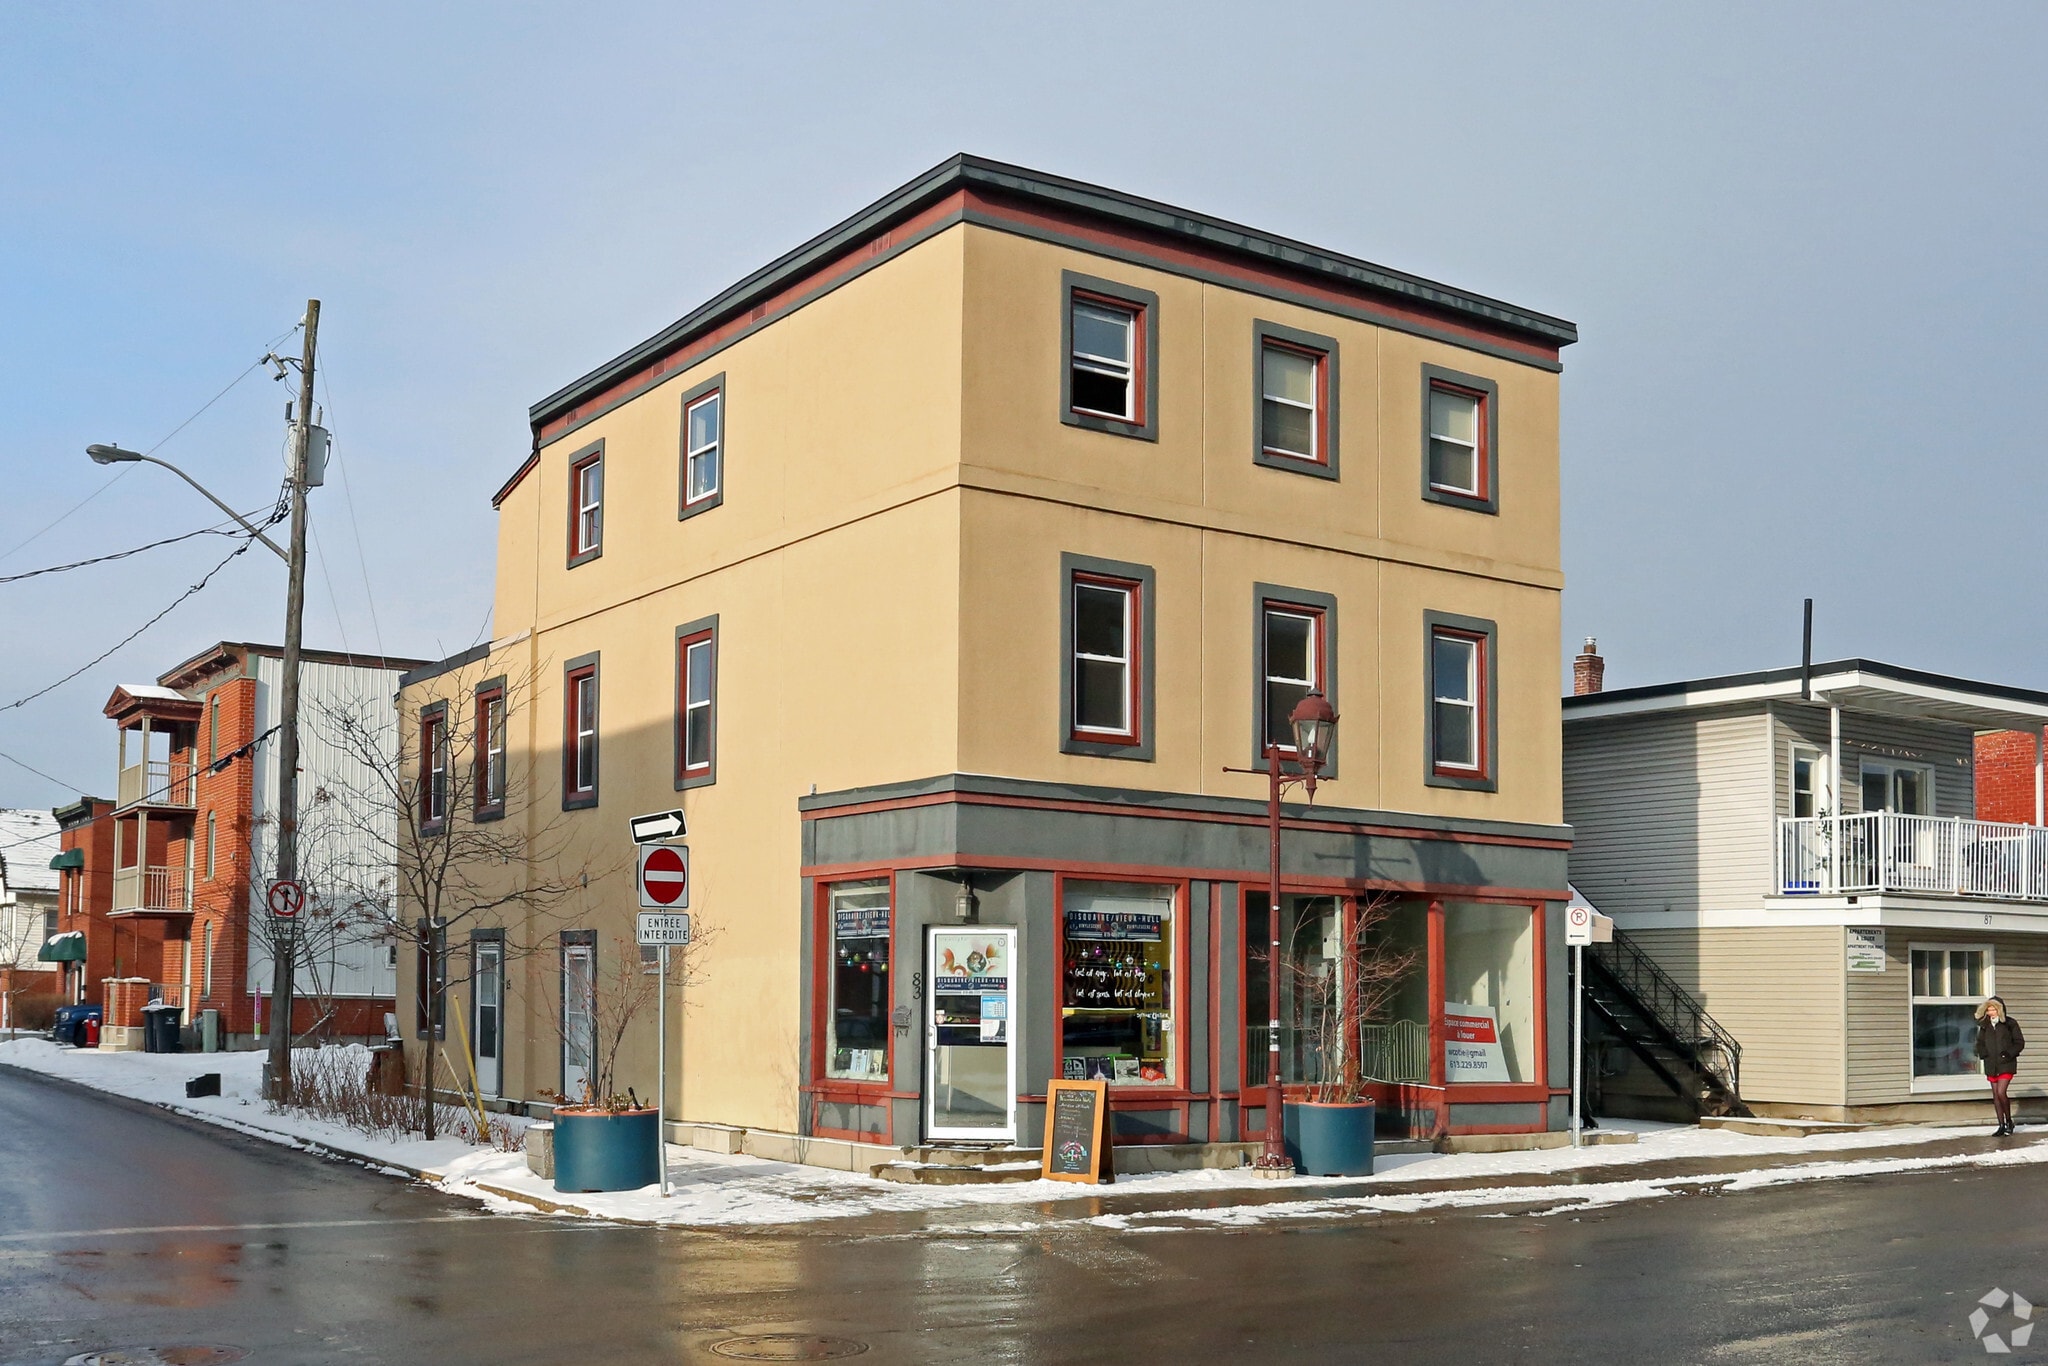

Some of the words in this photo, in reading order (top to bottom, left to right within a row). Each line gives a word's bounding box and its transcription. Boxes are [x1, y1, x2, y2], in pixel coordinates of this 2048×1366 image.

[648, 917, 680, 928] ENTRÉE
[1984, 914, 1993, 925] 87
[640, 930, 687, 939] INTERDITE
[1460, 1020, 1489, 1028] commercial
[1461, 1030, 1475, 1039] louer
